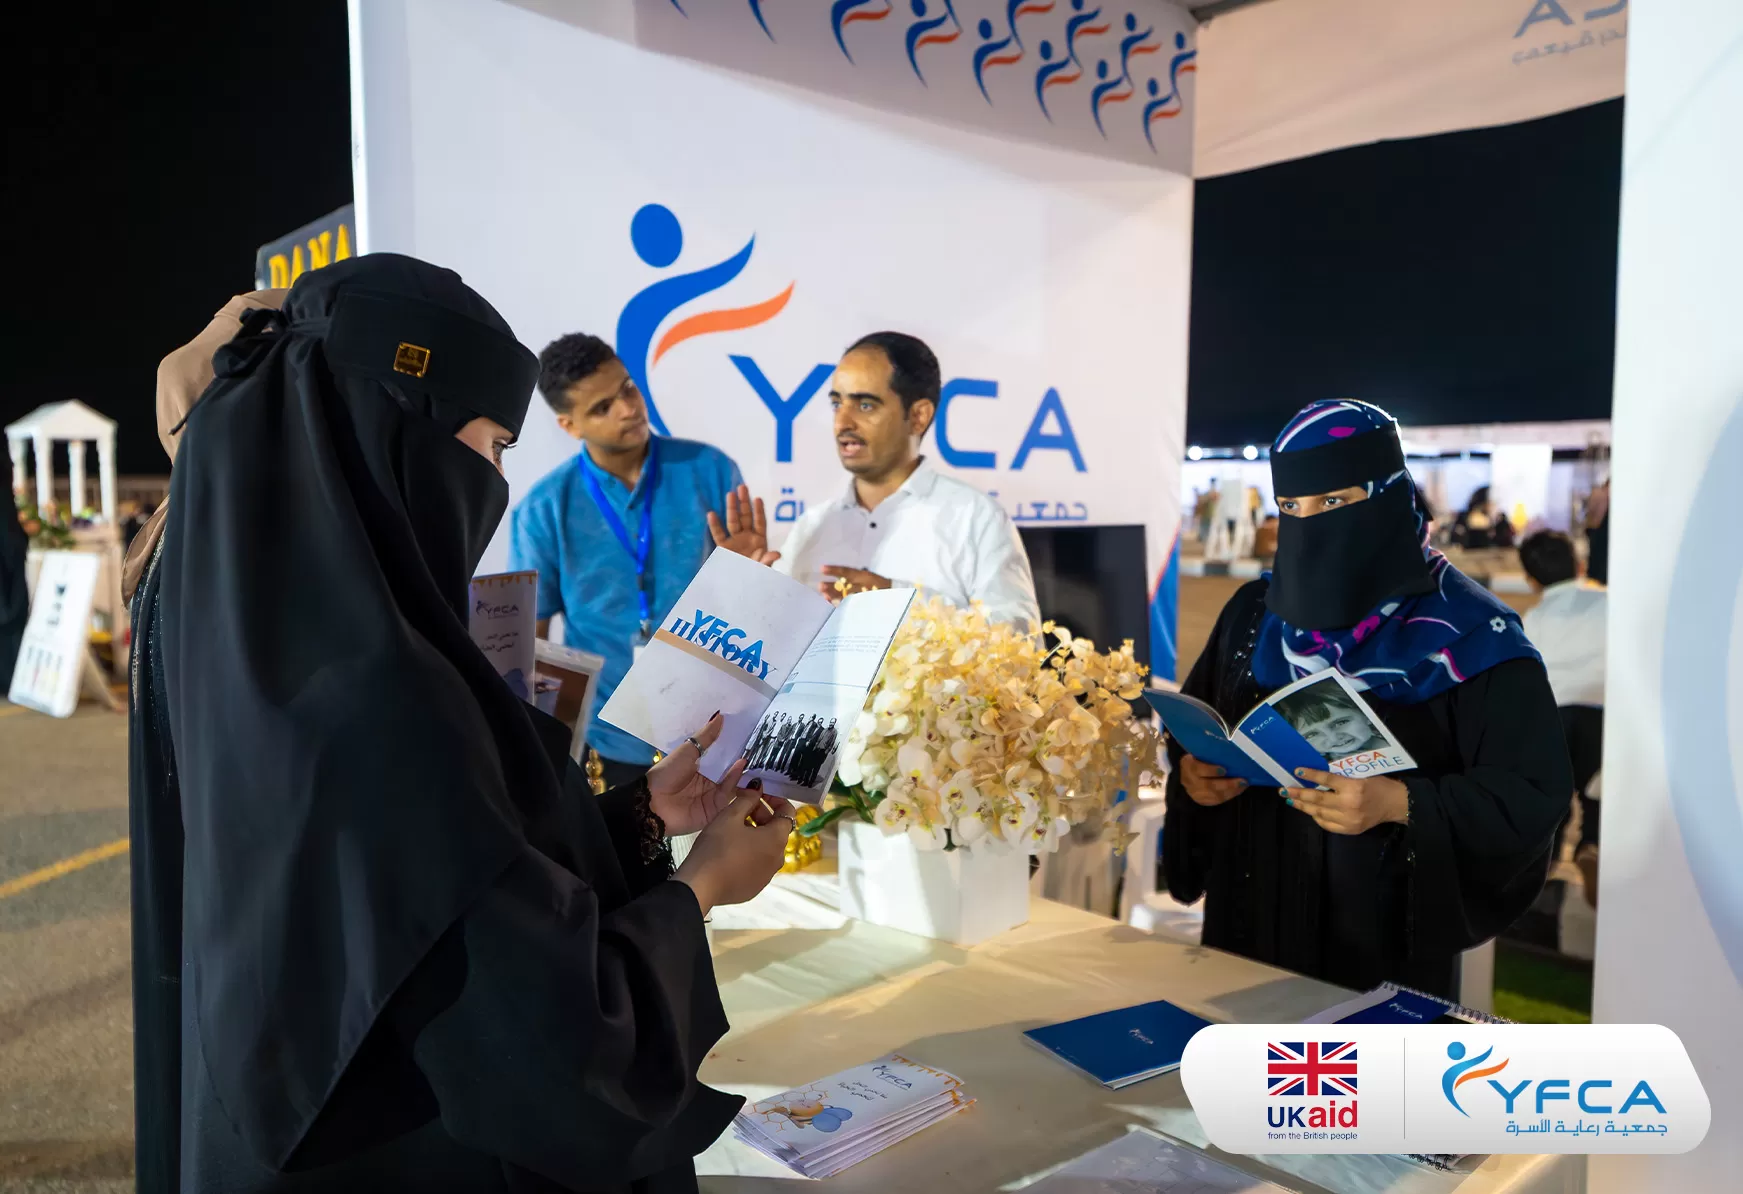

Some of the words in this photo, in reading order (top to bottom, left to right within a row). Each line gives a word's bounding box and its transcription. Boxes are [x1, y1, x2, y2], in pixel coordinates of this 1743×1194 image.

[728, 354, 1088, 473] YCA
[694, 609, 764, 669] YFCA
[1332, 751, 1387, 770] YFCA
